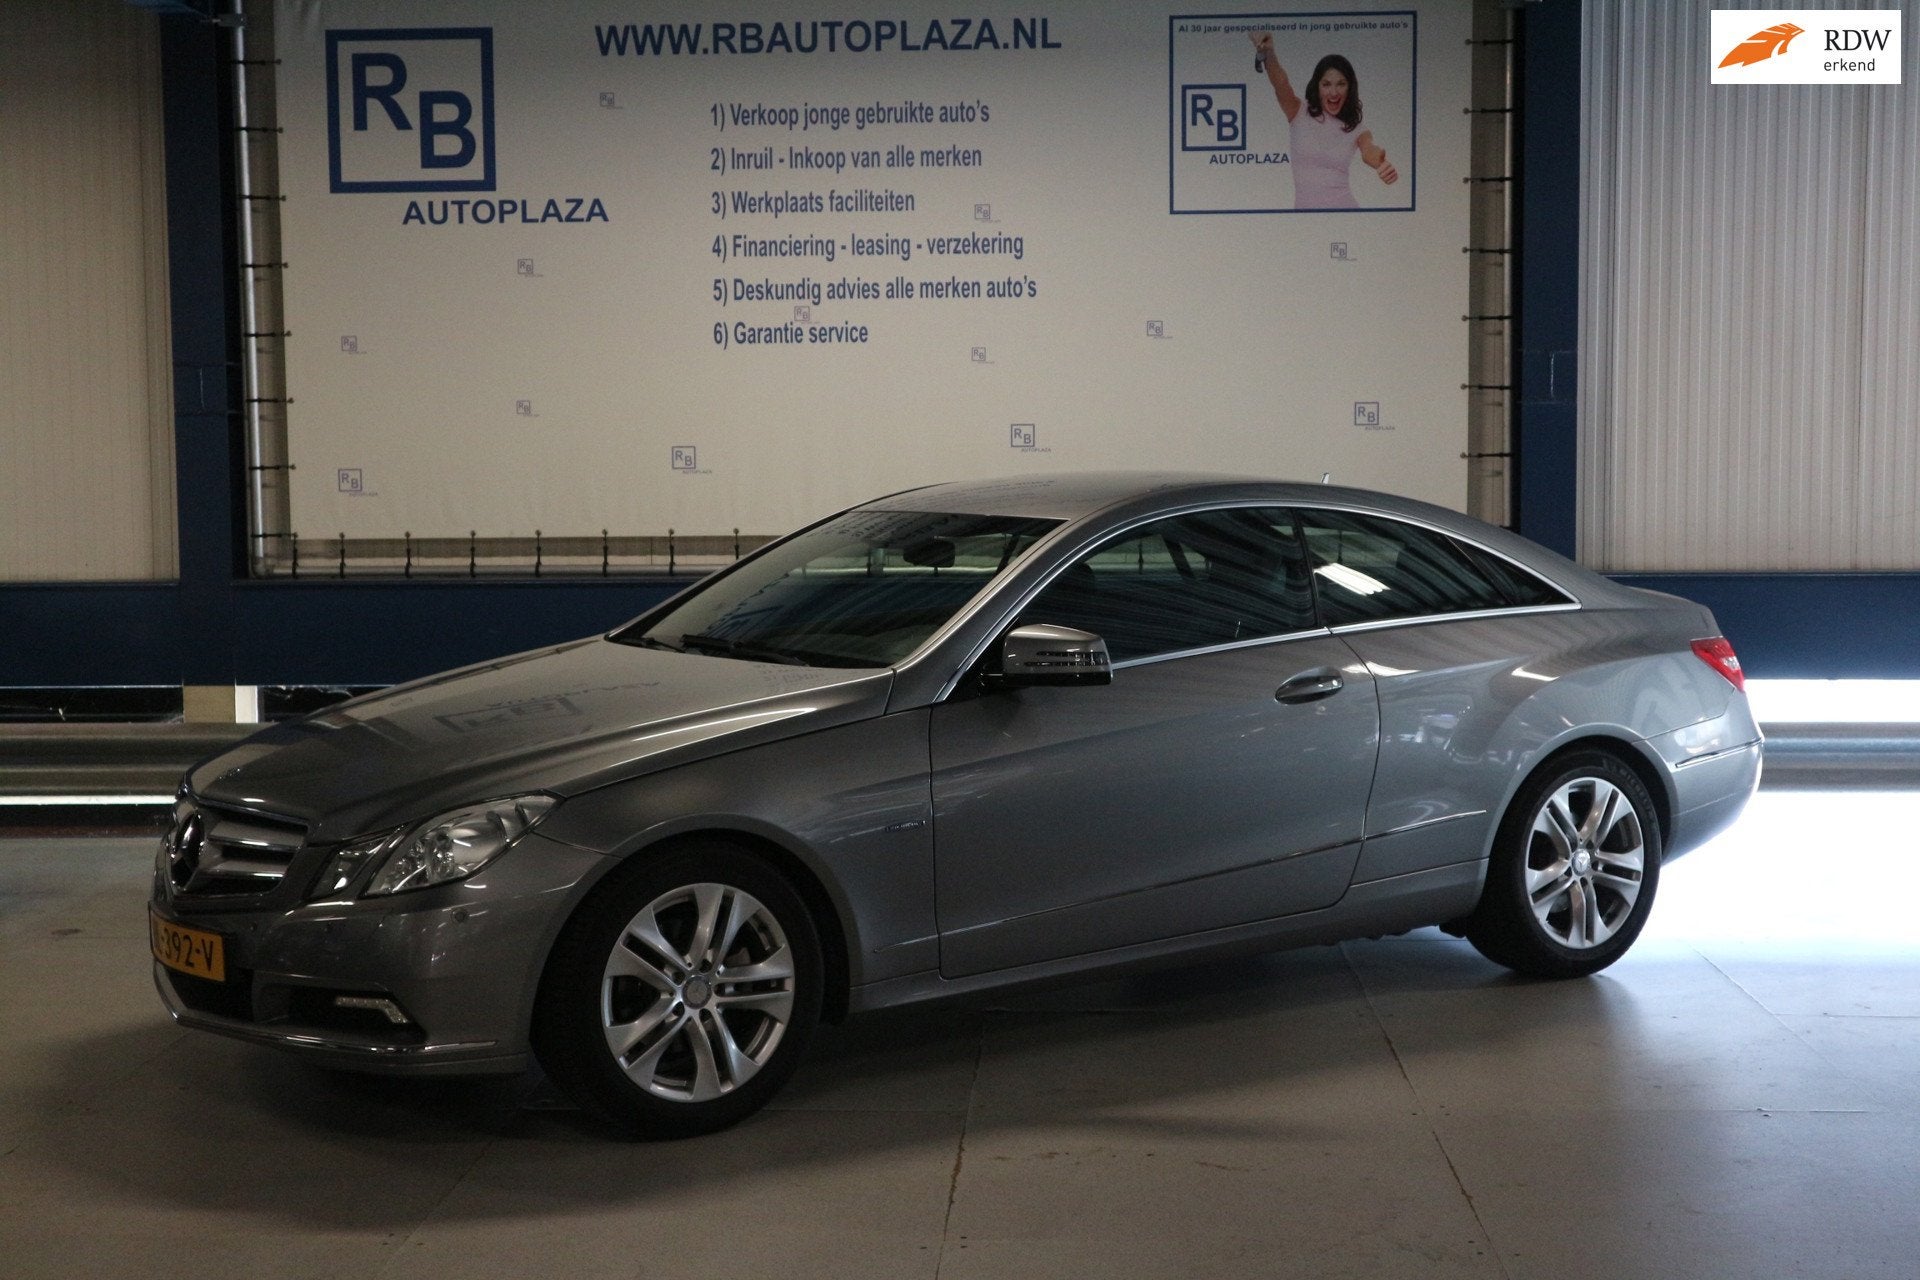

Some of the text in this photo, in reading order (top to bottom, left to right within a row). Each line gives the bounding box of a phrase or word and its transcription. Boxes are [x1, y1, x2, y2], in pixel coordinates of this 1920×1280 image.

[595, 18, 1061, 56] WWW.RBAUTOPLAZA.NL
[1310, 24, 1331, 32] jong
[1334, 22, 1377, 31] gebruikte
[351, 53, 476, 168] RB
[711, 99, 989, 131] 1) Verkoop jonge gebruikte auto's
[1191, 94, 1239, 141] RB
[711, 148, 725, 175] 2)
[732, 147, 772, 169] Inruil
[790, 147, 845, 173] Inkoop
[851, 151, 880, 168] van
[886, 145, 914, 167] alle
[921, 144, 981, 166] merken
[1209, 153, 1290, 164] AUTOPLAZA
[403, 199, 608, 225] AUTOPLAZA
[712, 189, 914, 219] 3) Werkplaats faciliteiten
[712, 236, 726, 262] 4)
[733, 235, 834, 262] Financiering
[852, 233, 910, 261] leasing
[927, 232, 1023, 259] verzekering
[714, 276, 1036, 306] 5) Deskundig advies alle merken auto's
[714, 321, 868, 349] 6) Garantie service
[1358, 406, 1375, 422] RB
[1014, 428, 1031, 444] RB
[675, 450, 692, 466] RB
[341, 473, 358, 488] RB
